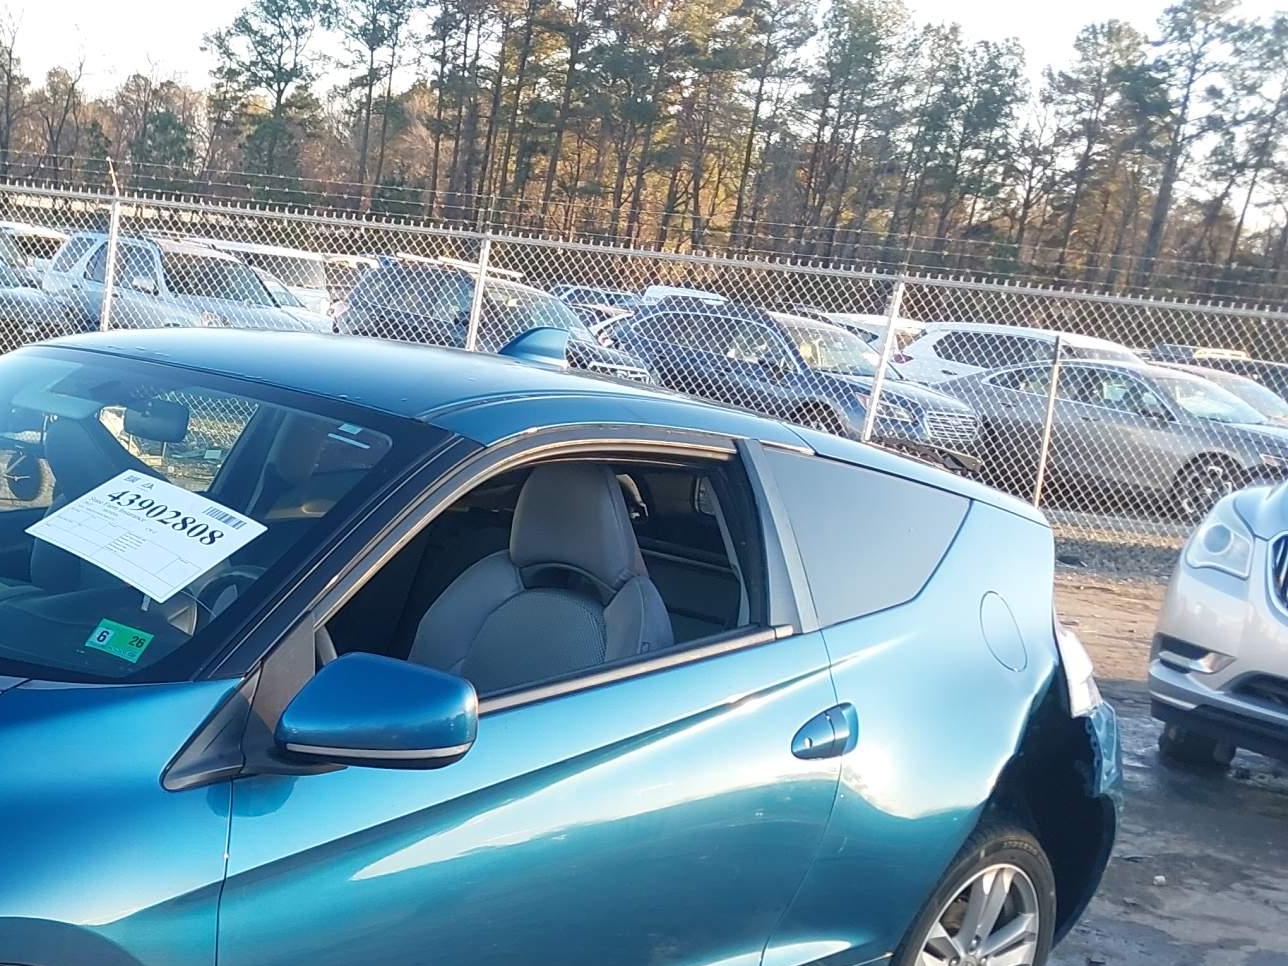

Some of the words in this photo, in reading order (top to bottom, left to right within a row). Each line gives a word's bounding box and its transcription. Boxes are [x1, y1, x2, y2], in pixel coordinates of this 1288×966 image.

[107, 490, 225, 545] 43902808
[96, 630, 110, 643] 6
[128, 635, 146, 648] 26
